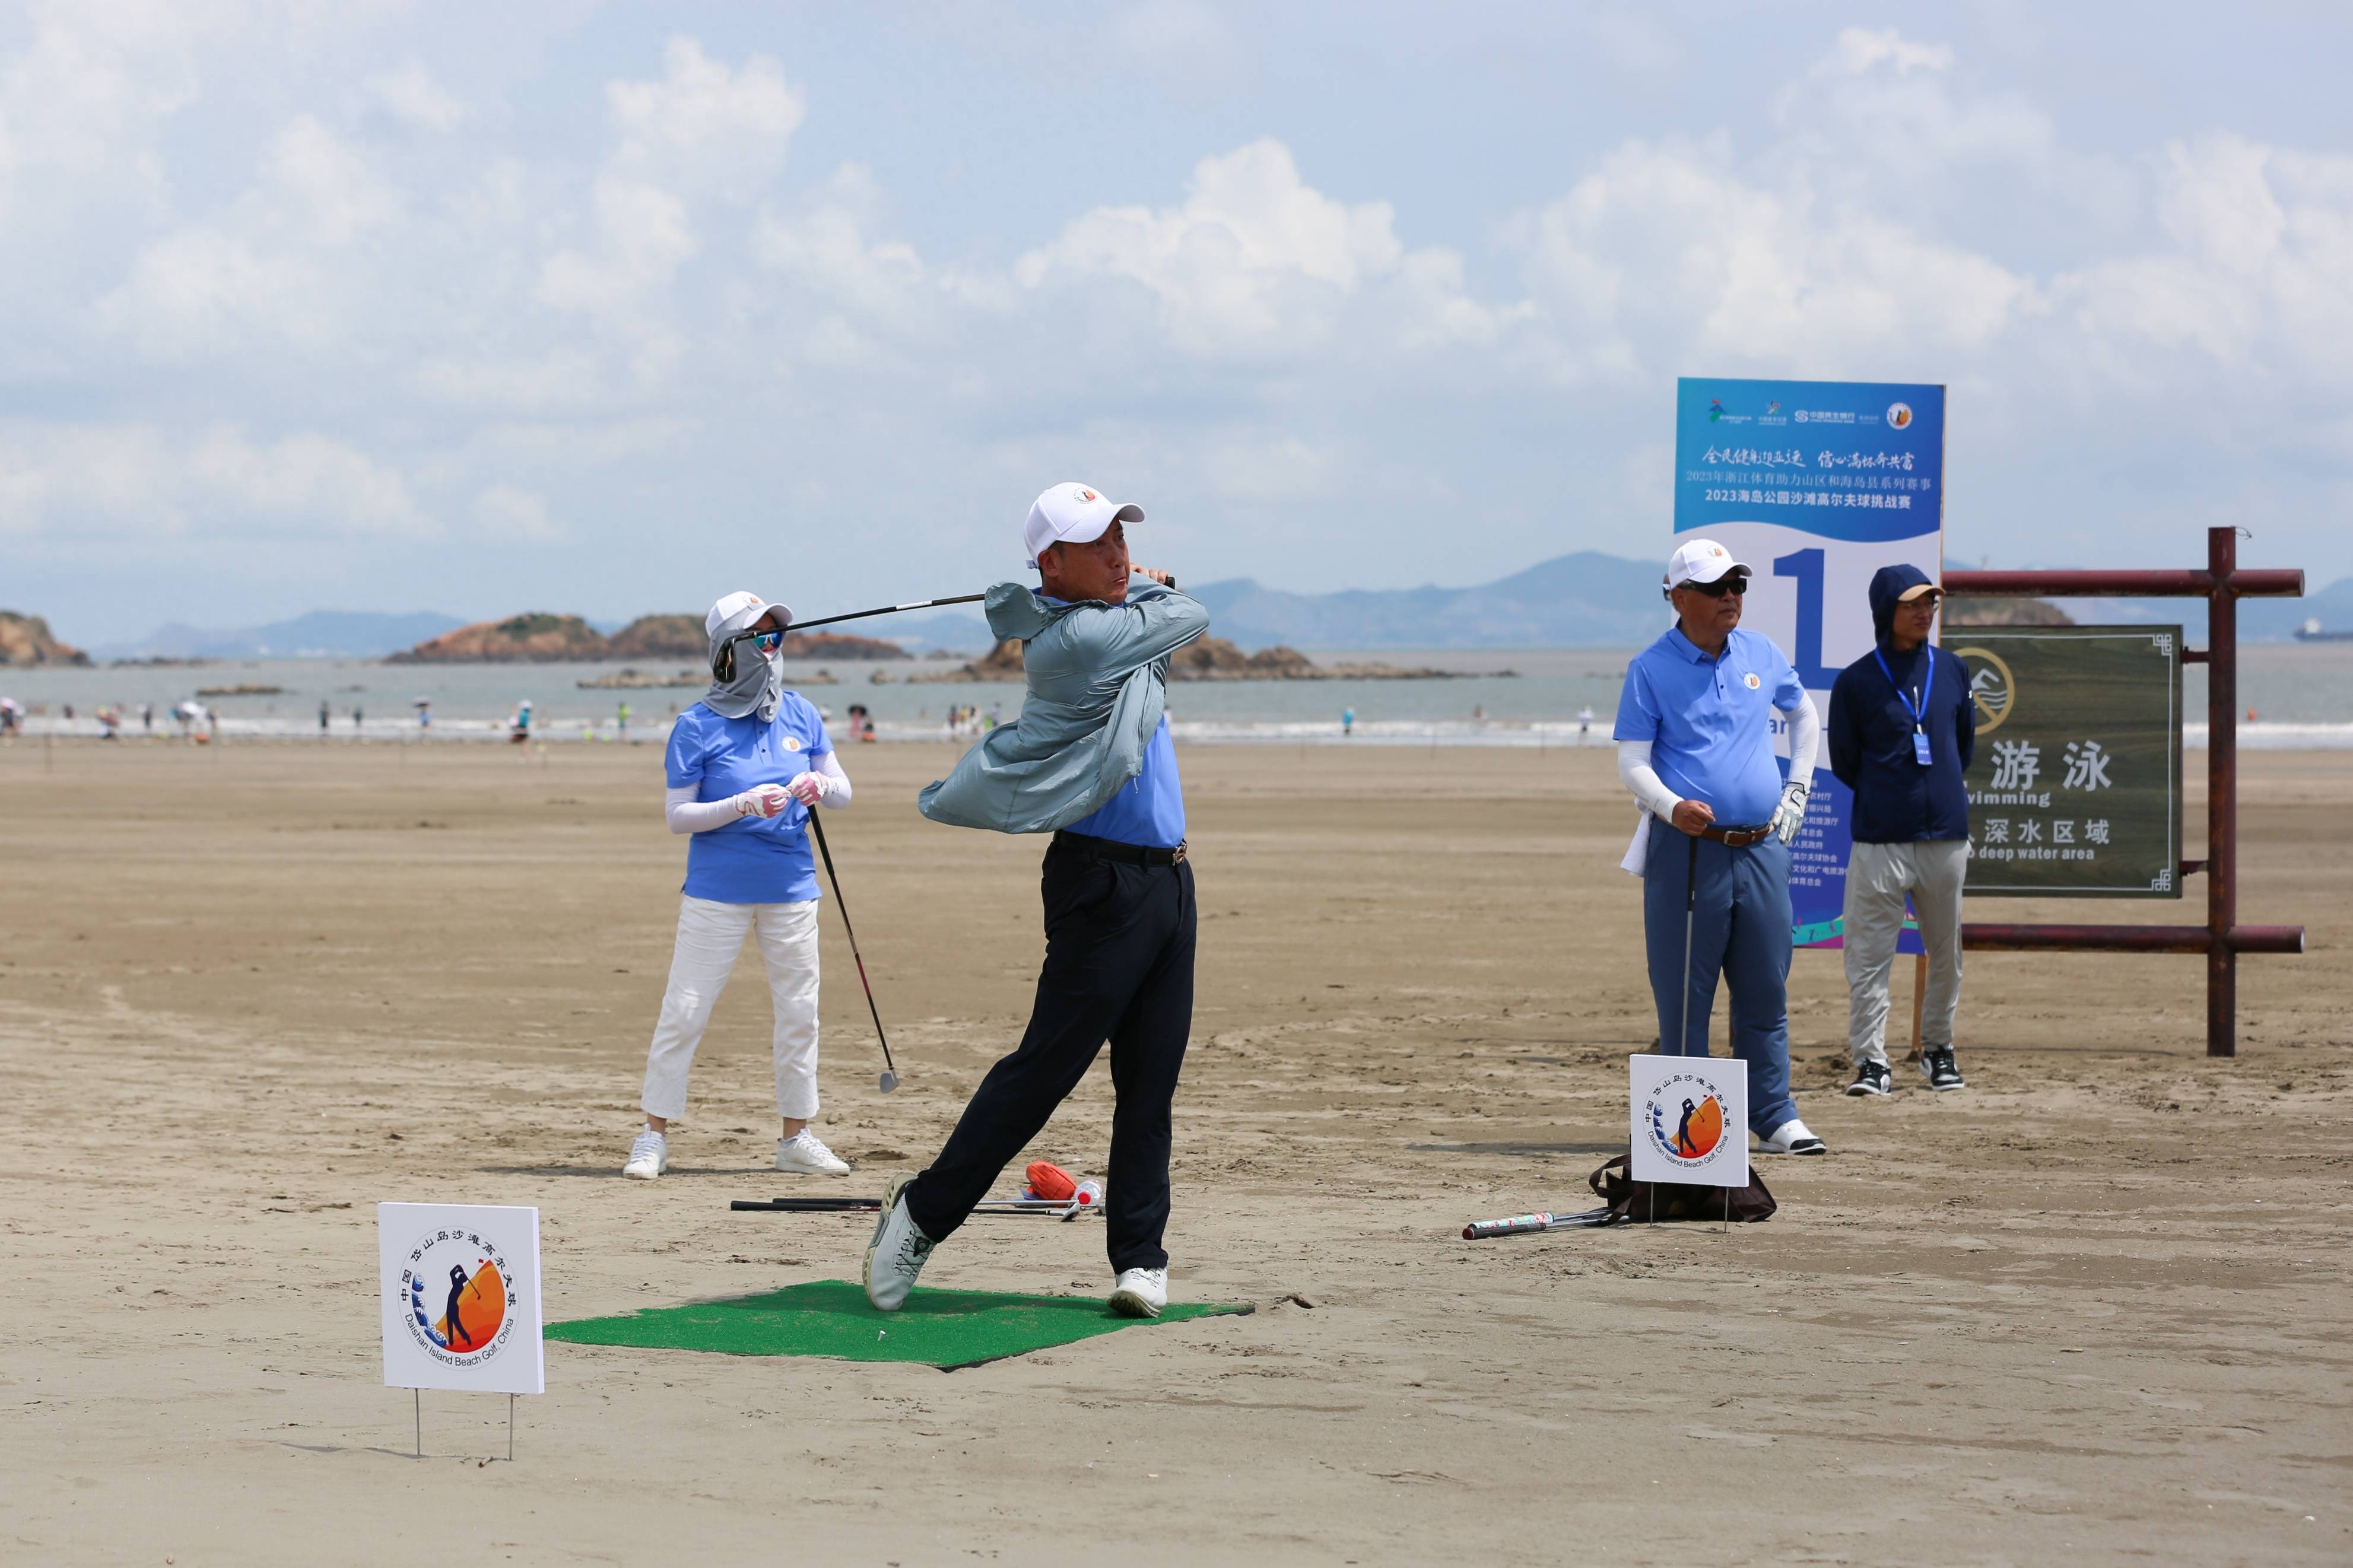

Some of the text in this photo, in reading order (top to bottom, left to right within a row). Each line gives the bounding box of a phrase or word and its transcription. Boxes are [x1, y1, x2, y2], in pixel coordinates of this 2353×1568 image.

[1702, 444, 1914, 470] 全民健身迎亚运 信心满怀奔共富
[1687, 470, 1931, 491] 2023年浙江体育助力山区和海岛县系列赛事
[1705, 489, 1910, 510] 2023海岛公园沙滩高尔夫球挑战赛
[1773, 548, 1843, 690] 1
[1768, 719, 1788, 734] ar
[1963, 740, 2111, 791] 游泳
[1810, 792, 1833, 802] 农村厅
[1968, 791, 2051, 807] imming
[1797, 828, 1823, 838] 育总会
[1790, 853, 1837, 863] 高尔夫球协会
[1979, 846, 2014, 861] deep
[2017, 847, 2057, 860] water
[2062, 848, 2094, 860] area
[1793, 864, 1847, 875] 文化和广电旅游
[1789, 877, 1821, 886] 体育总会
[1645, 1074, 1731, 1128] 中国岱山岛沙滩高尔夫球
[1647, 1131, 1665, 1156] Daishan
[1665, 1154, 1682, 1166] Island
[1704, 1152, 1718, 1163] Golf,
[1716, 1136, 1728, 1153] China
[401, 1229, 516, 1307] 中国岱山岛沙滩高尔夫球
[405, 1313, 514, 1366] Daishan Island Beach Golf, China
